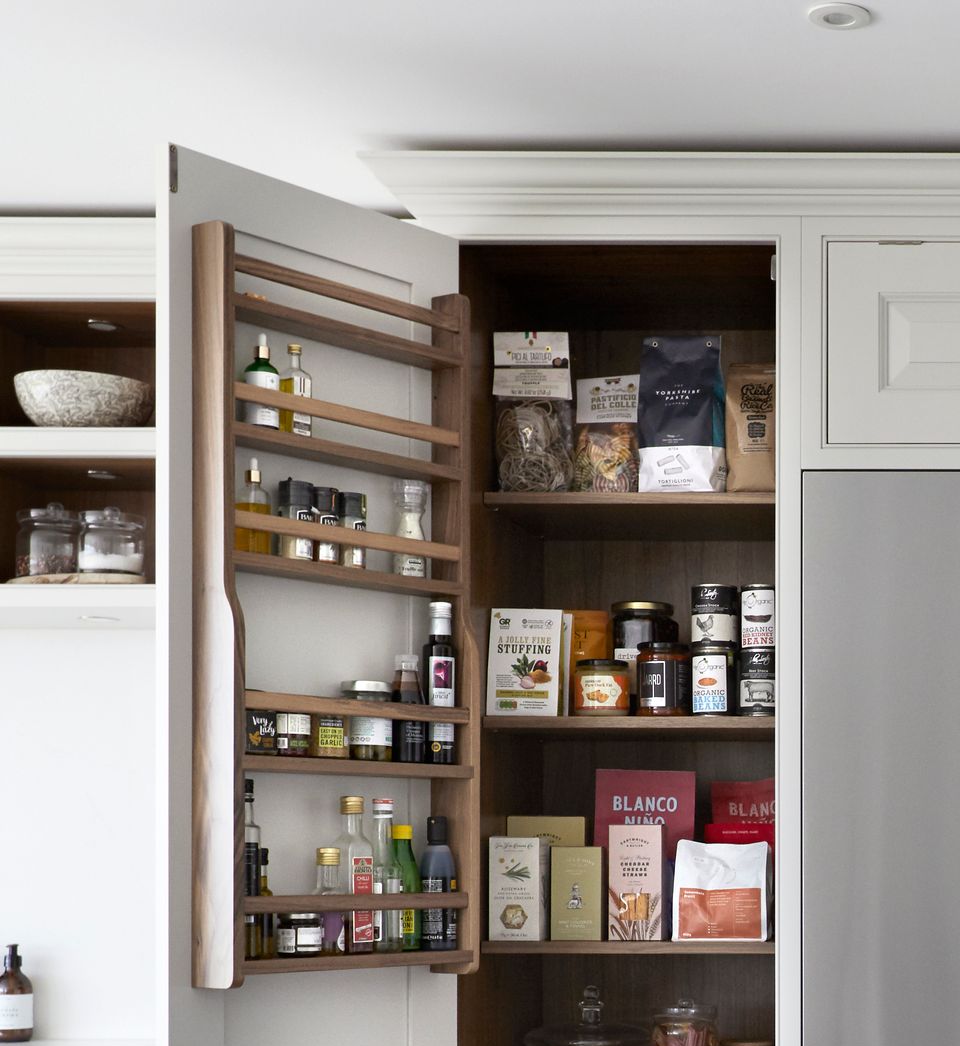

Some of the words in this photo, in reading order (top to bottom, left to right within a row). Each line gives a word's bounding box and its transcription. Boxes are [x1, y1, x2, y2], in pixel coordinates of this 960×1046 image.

[591, 394, 637, 403] PASTIFICIO
[609, 401, 637, 409] COLLE
[532, 636, 552, 644] FINE
[743, 637, 774, 646] BEANS
[497, 644, 551, 654] STUFFING
[694, 702, 726, 711] BEANS
[252, 716, 268, 726] Very
[260, 721, 275, 736] Lazy
[613, 795, 677, 812] BLANCO
